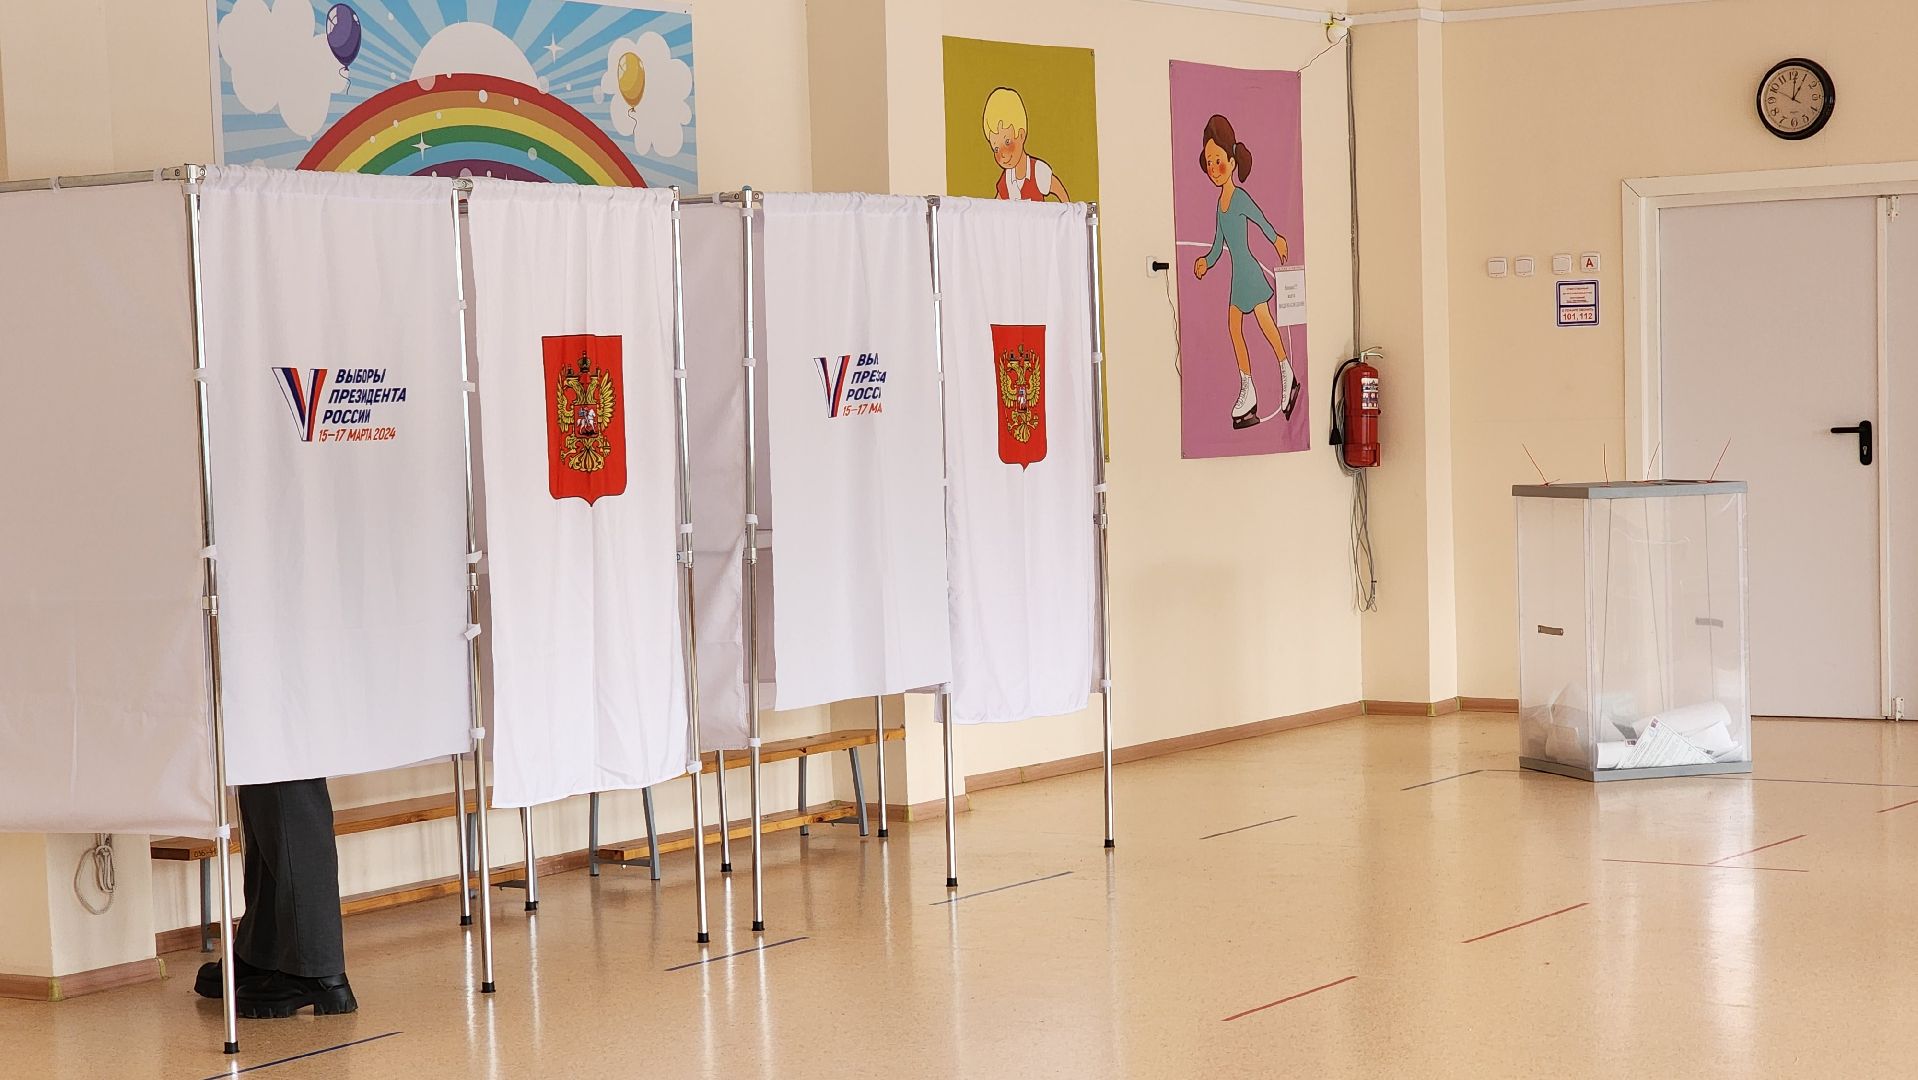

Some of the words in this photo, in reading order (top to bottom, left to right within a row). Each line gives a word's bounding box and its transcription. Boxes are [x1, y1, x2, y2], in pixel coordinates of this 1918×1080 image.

[1789, 71, 1798, 80] 12
[1770, 83, 1780, 93] 10
[335, 368, 386, 384] ВЫБОРЫ
[328, 387, 407, 405] ПРЕЗИДЕНТА
[322, 408, 371, 424] РОССИИ
[347, 428, 372, 441] МАРТА
[373, 427, 396, 441] 2024
